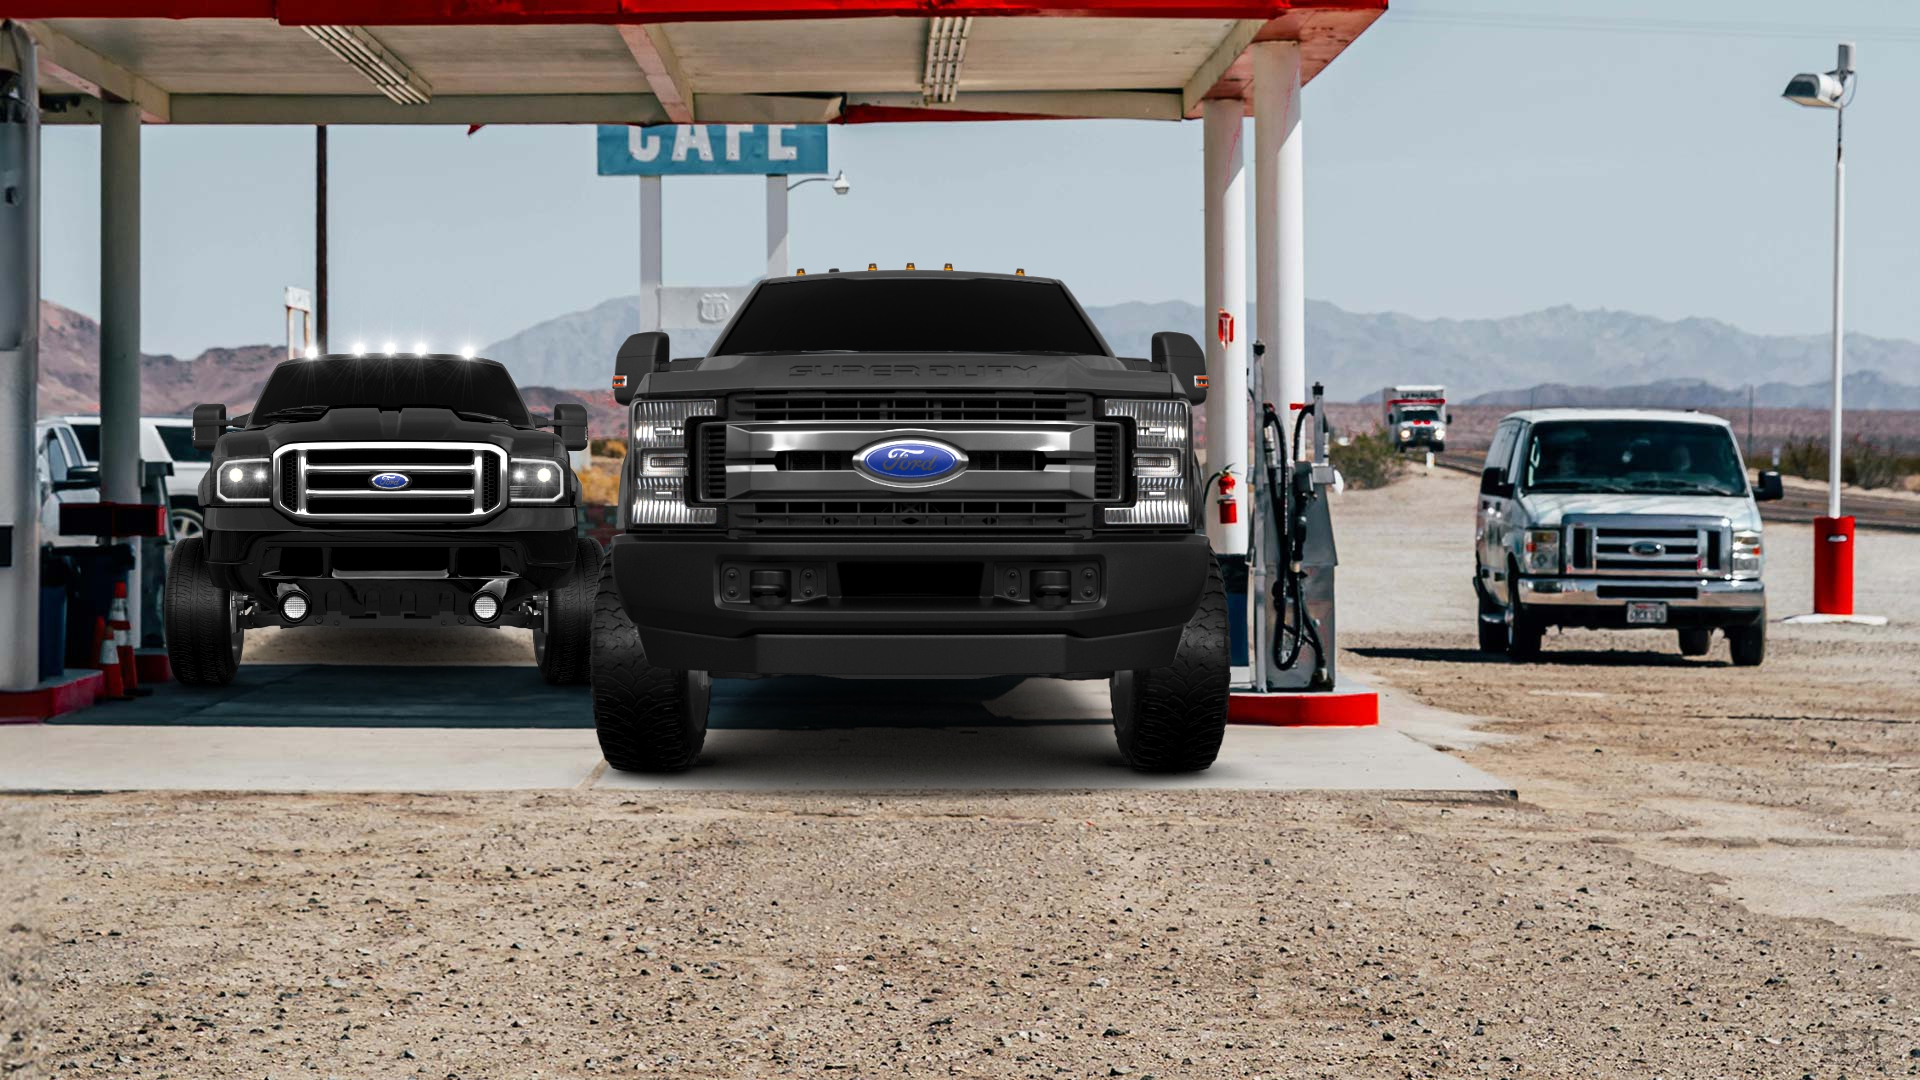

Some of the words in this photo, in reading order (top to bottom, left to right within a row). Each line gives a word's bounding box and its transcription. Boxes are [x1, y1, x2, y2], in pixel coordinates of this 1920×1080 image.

[788, 364, 921, 377] SUPER
[928, 364, 1038, 378] DUTY
[882, 448, 939, 471] Ford
[380, 475, 401, 486] Ford
